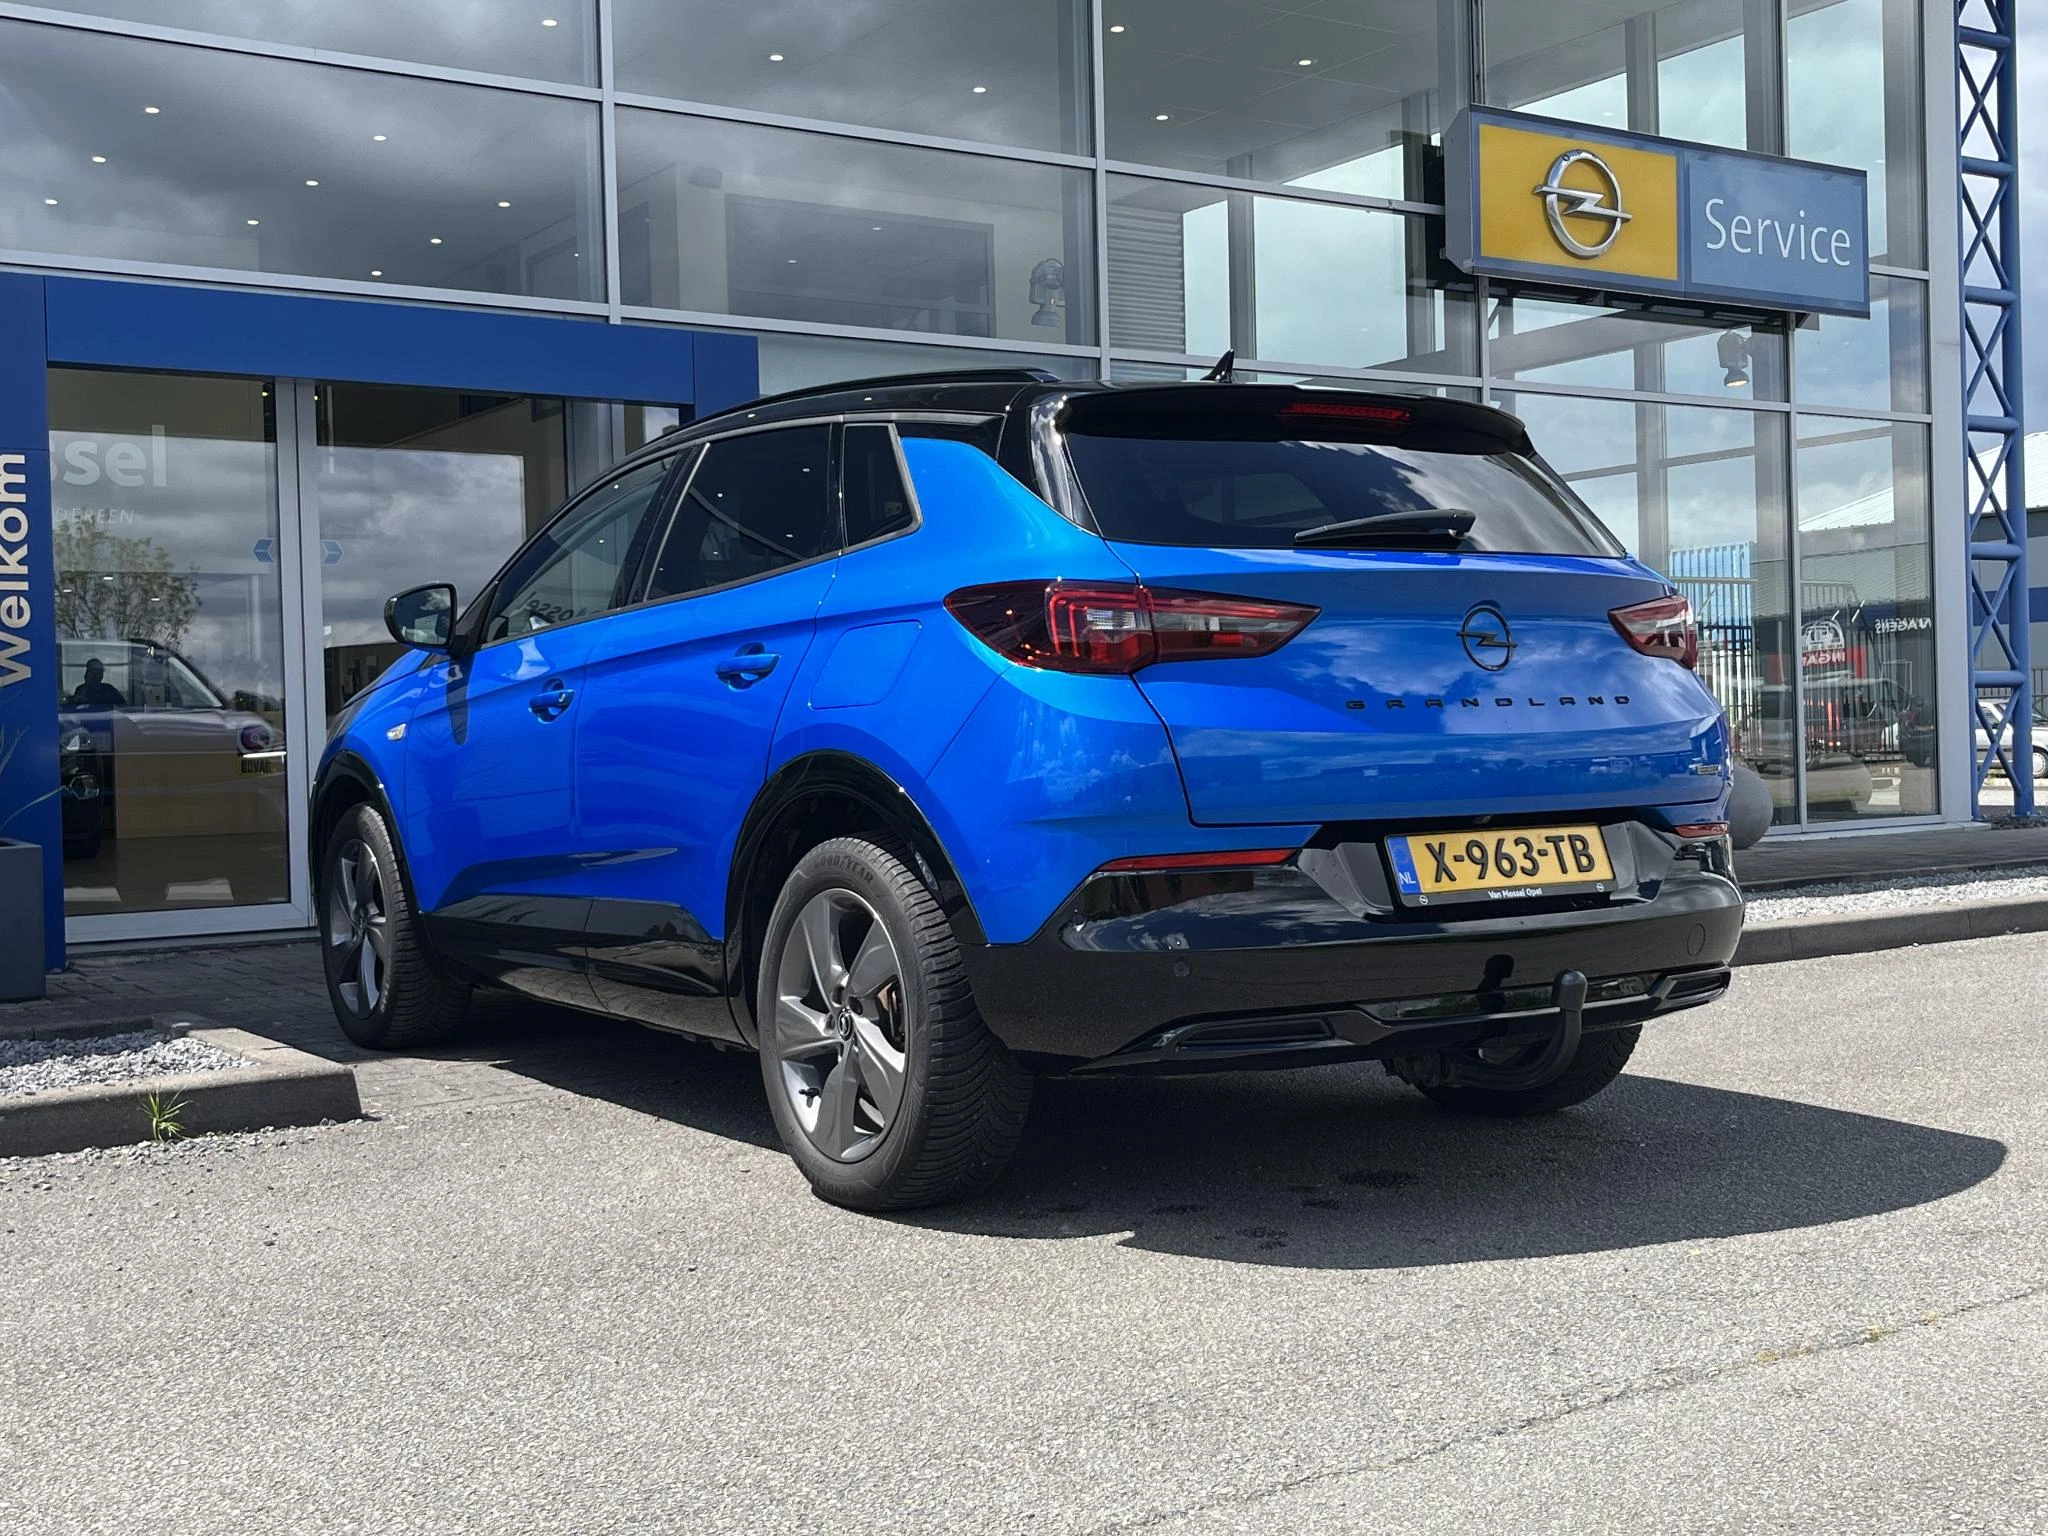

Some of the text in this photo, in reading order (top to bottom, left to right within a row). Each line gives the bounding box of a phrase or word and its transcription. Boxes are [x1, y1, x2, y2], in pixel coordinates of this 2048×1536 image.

[1705, 198, 1851, 266] Service
[50, 424, 167, 488] sel
[0, 454, 32, 688] Welkom
[1345, 695, 1630, 711] GRANDLAND
[1399, 872, 1416, 885] NL
[1425, 834, 1596, 883] X-963-TB
[1487, 887, 1543, 899] Van Mossel Opel
